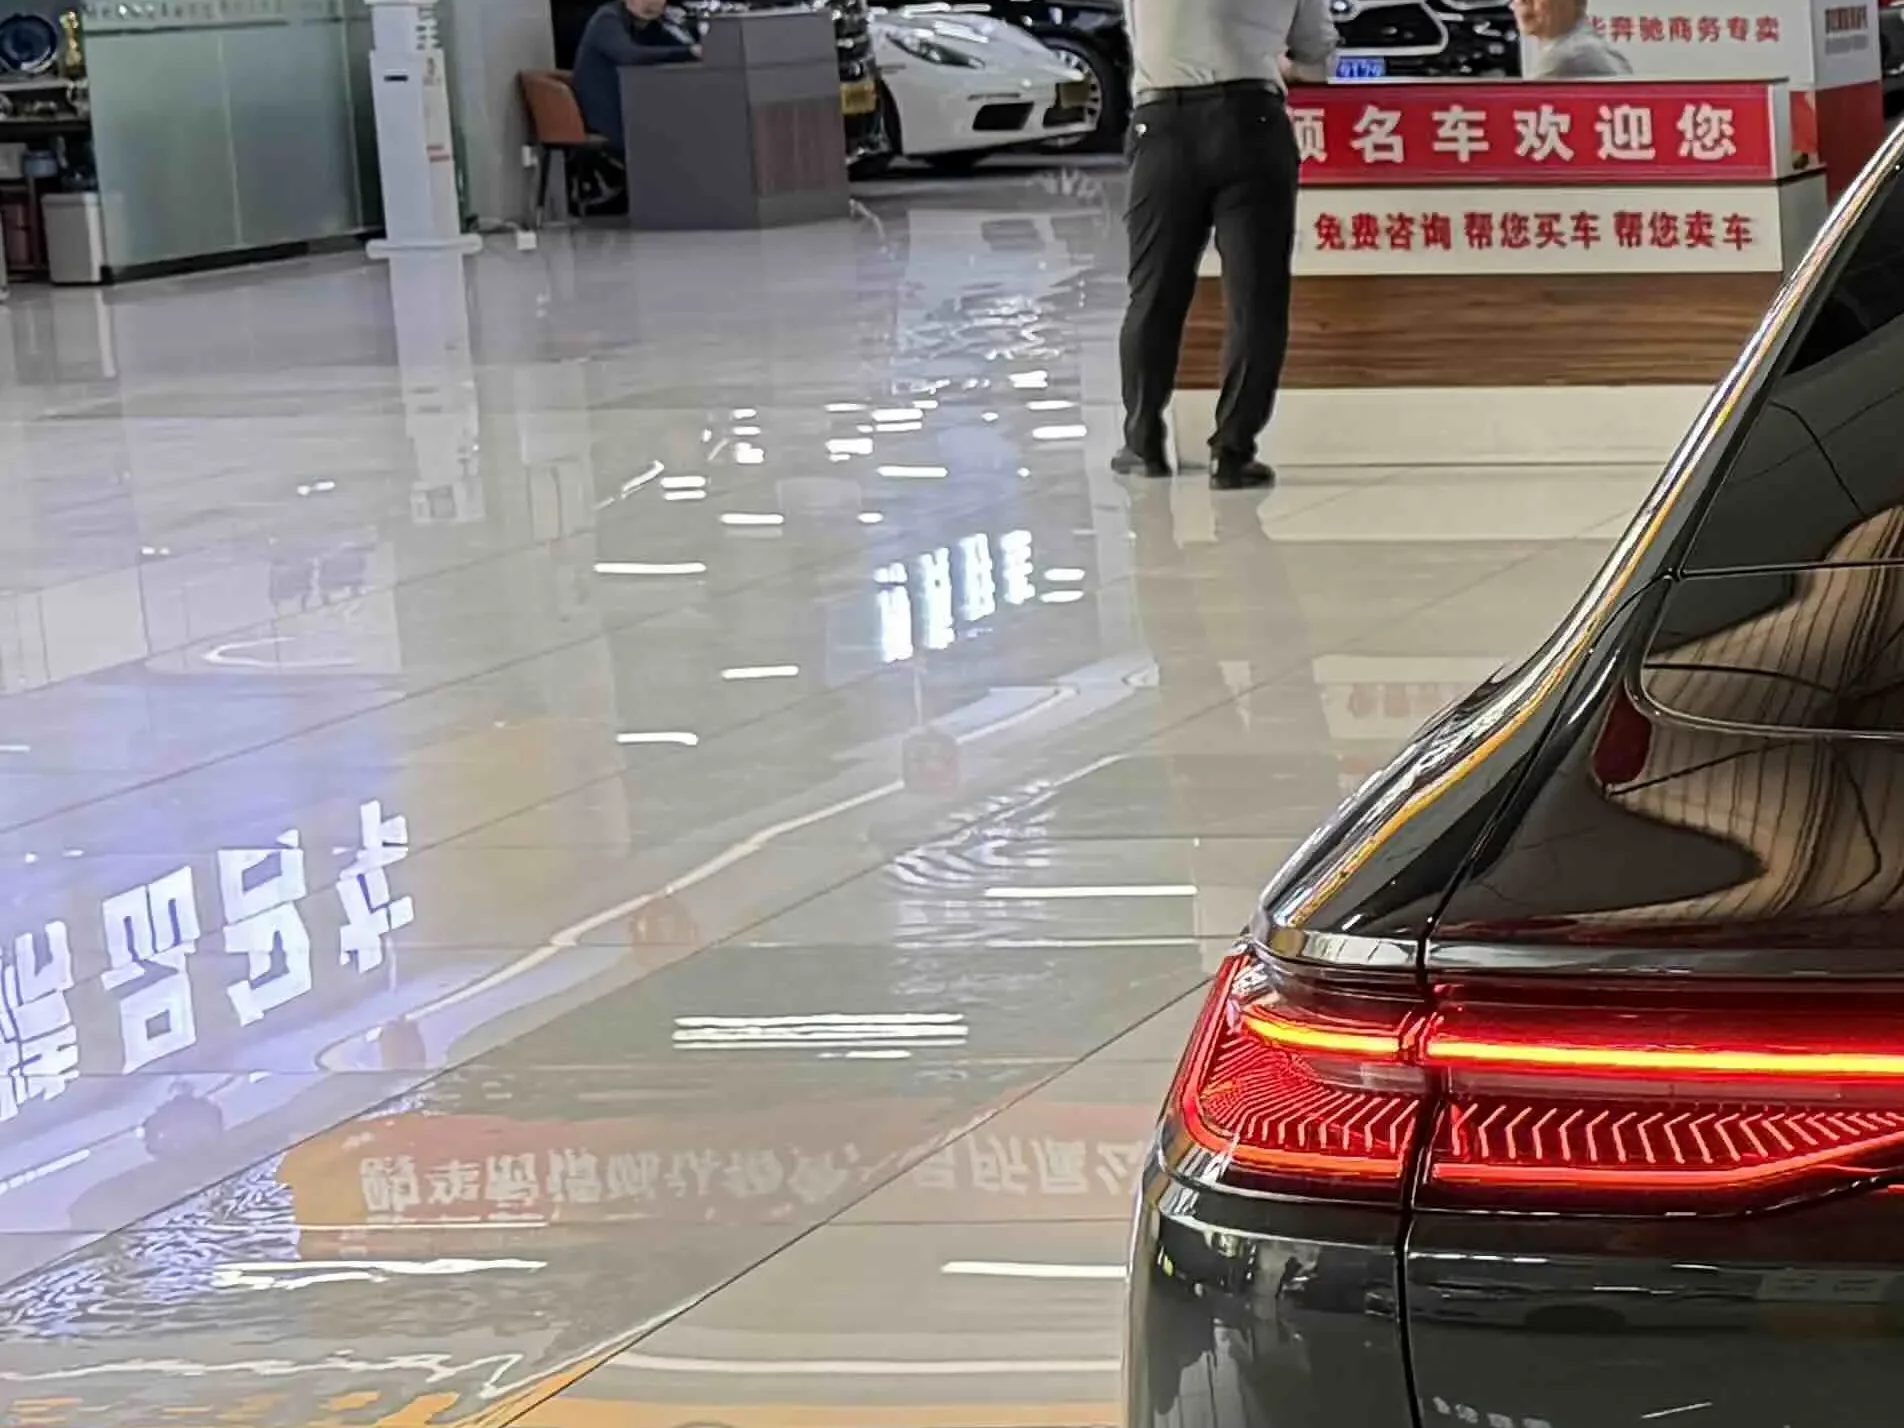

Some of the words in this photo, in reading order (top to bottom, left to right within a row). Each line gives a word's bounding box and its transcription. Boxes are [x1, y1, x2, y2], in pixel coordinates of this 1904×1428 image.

[1313, 212, 1452, 253] 免费咨询
[1464, 211, 1602, 252] 帮您买车
[1614, 210, 1755, 253] 帮您卖车
